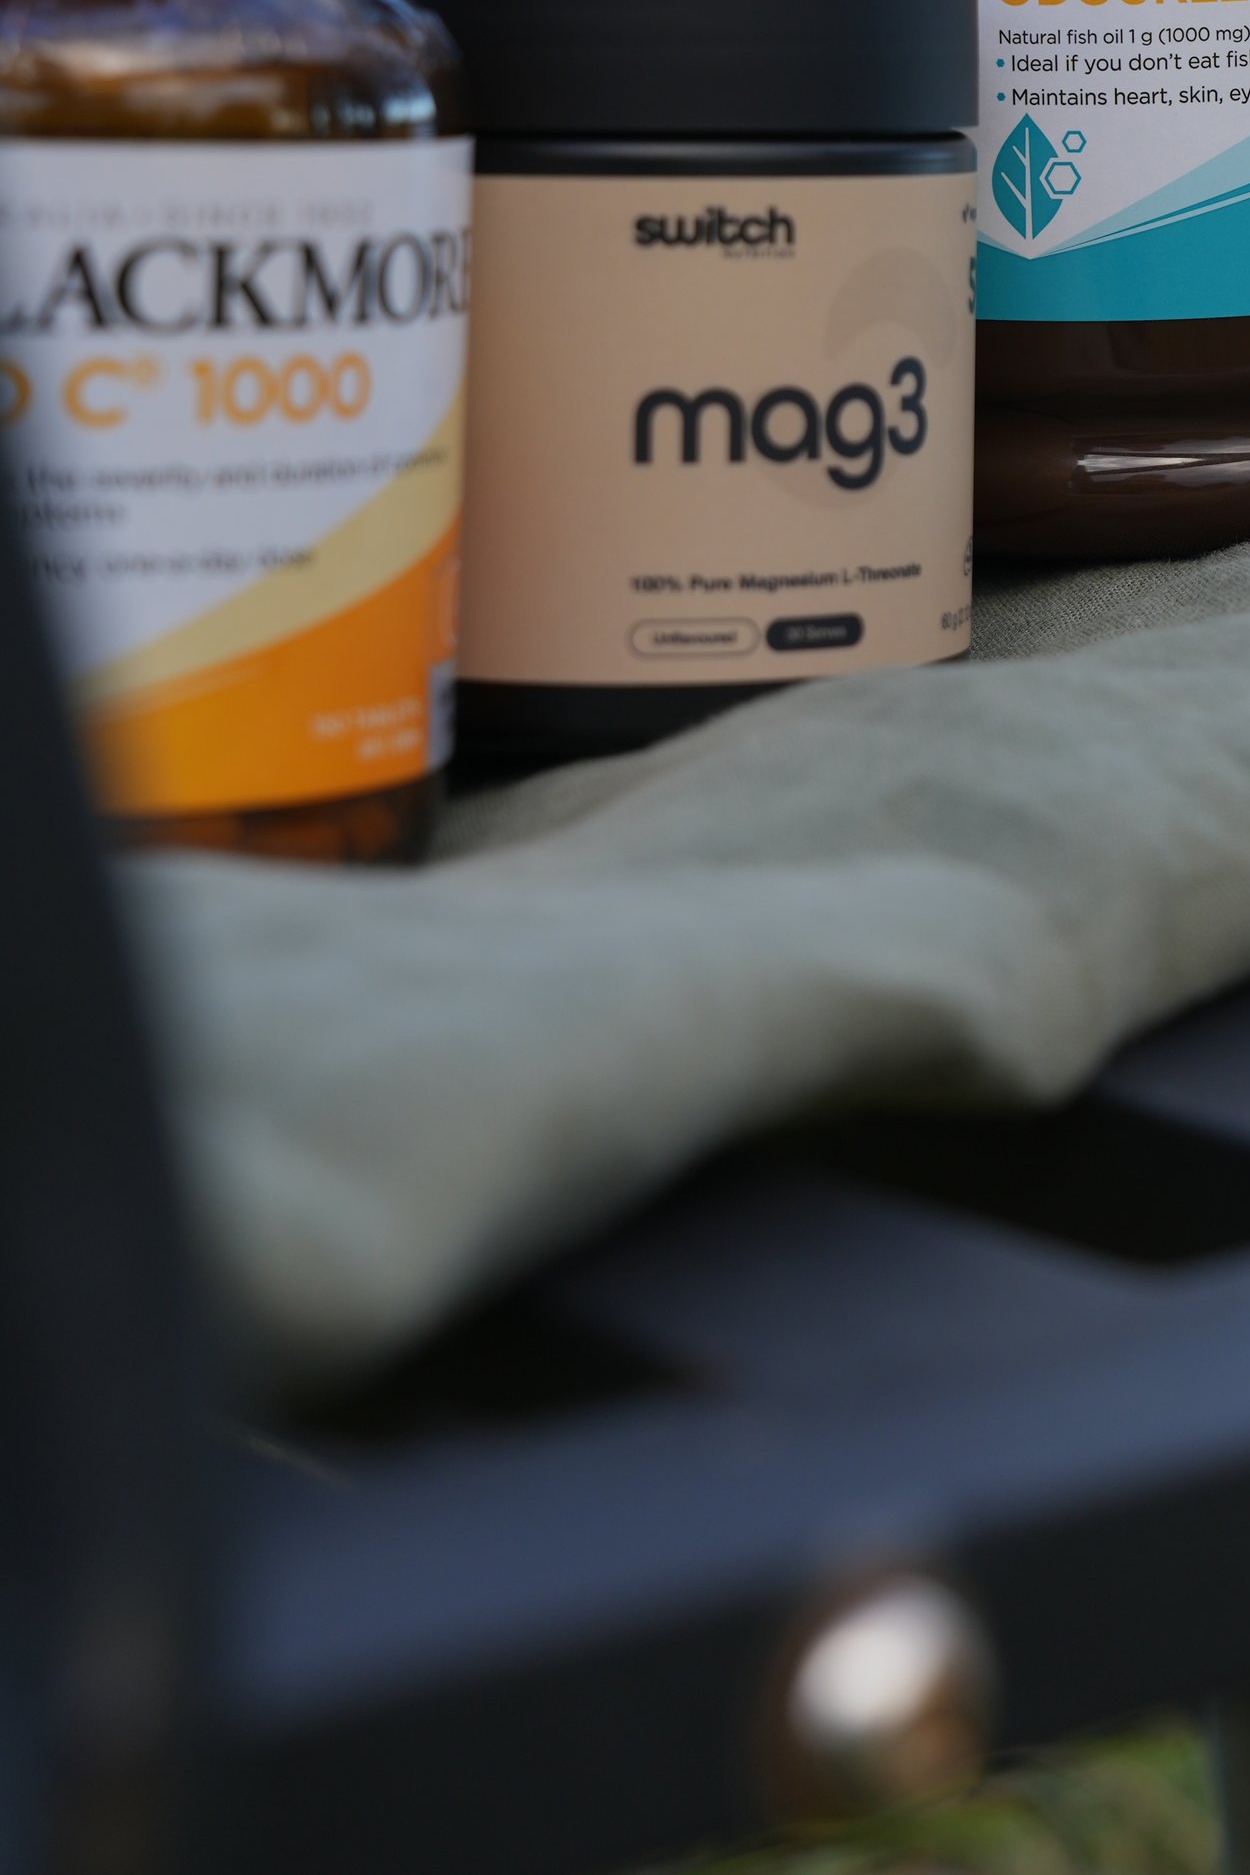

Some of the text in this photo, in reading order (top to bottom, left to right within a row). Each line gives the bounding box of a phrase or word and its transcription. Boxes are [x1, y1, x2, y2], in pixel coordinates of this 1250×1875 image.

[1000, 25, 1250, 45] Natural fish oil 1 g (1000 mg)
[1012, 55, 1057, 72] Ideal
[1066, 55, 1078, 71] if
[1084, 58, 1121, 74] you
[1129, 53, 1182, 71] don't
[1188, 52, 1220, 68] eat
[1012, 89, 1107, 105] Maintains
[1114, 88, 1172, 106] heart,
[1179, 86, 1223, 104] skin,
[635, 206, 794, 246] switch
[191, 351, 371, 423] 1000
[632, 576, 682, 594] 100%
[691, 575, 731, 591] Pure
[740, 572, 837, 594] Magnesium
